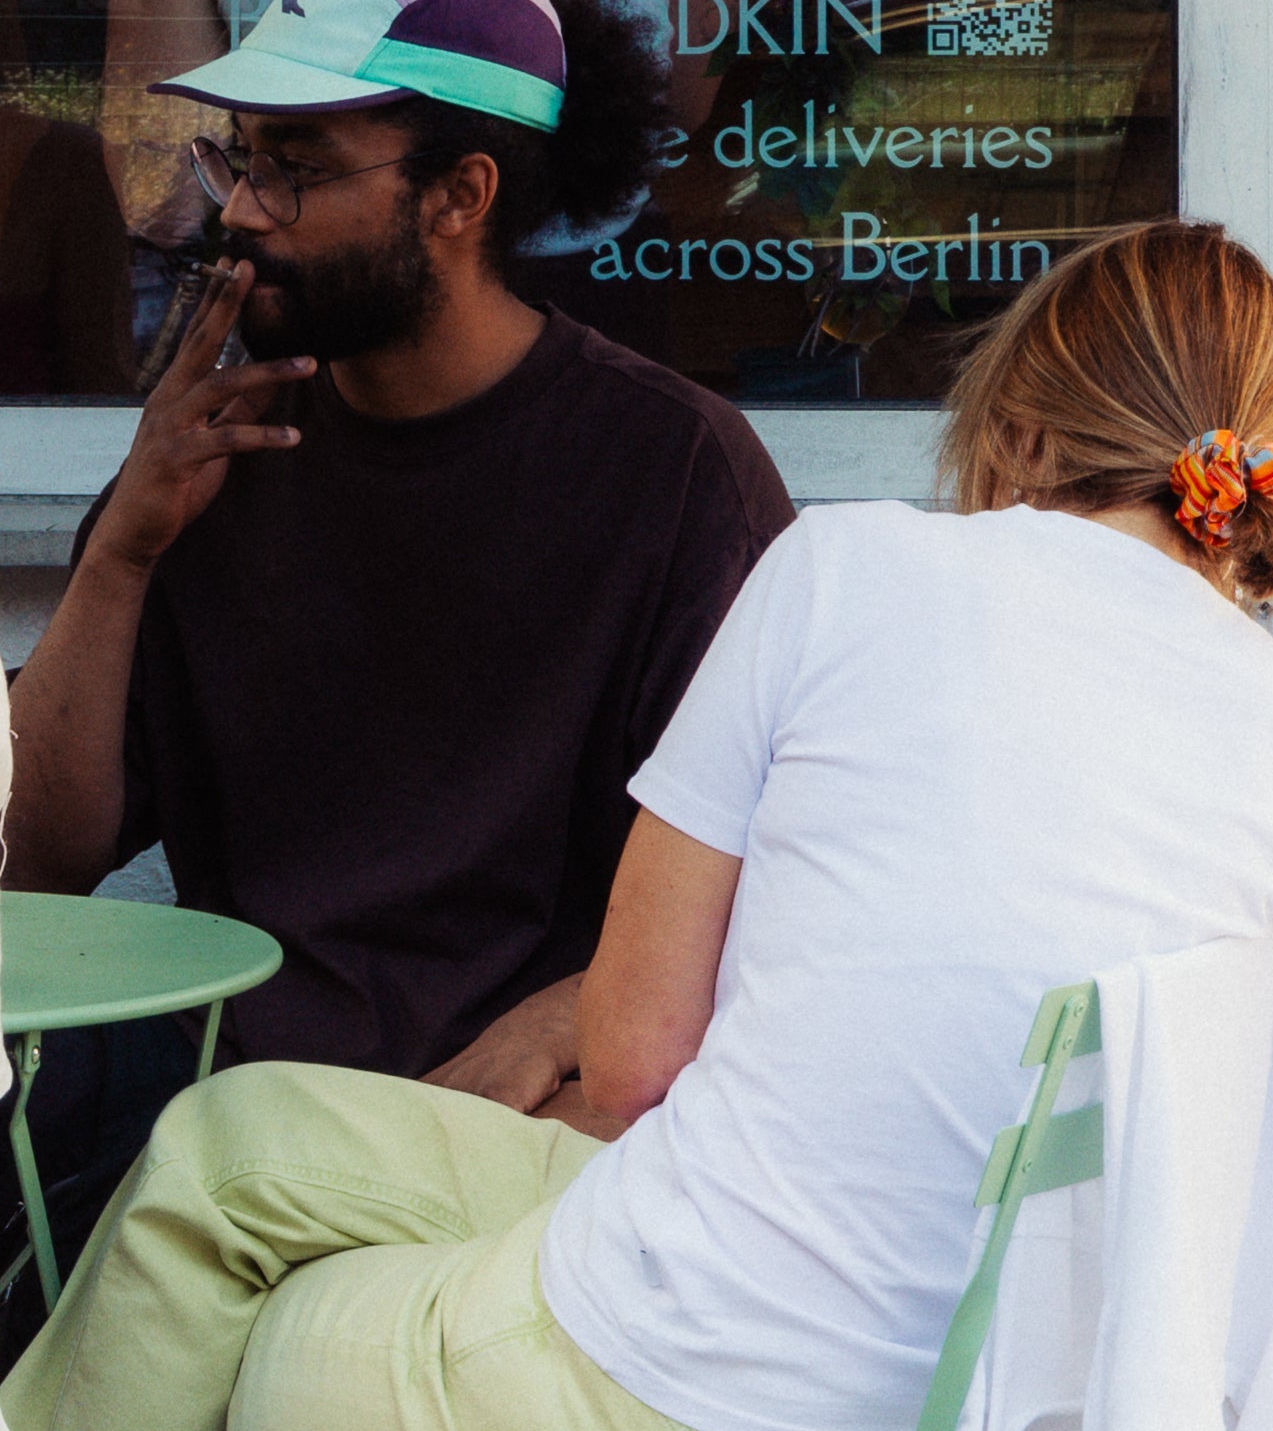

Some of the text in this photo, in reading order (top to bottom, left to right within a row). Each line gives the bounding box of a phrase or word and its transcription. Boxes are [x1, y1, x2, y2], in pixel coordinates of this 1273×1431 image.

[713, 100, 1054, 169] deliveries
[589, 211, 1051, 282] across Berlin
